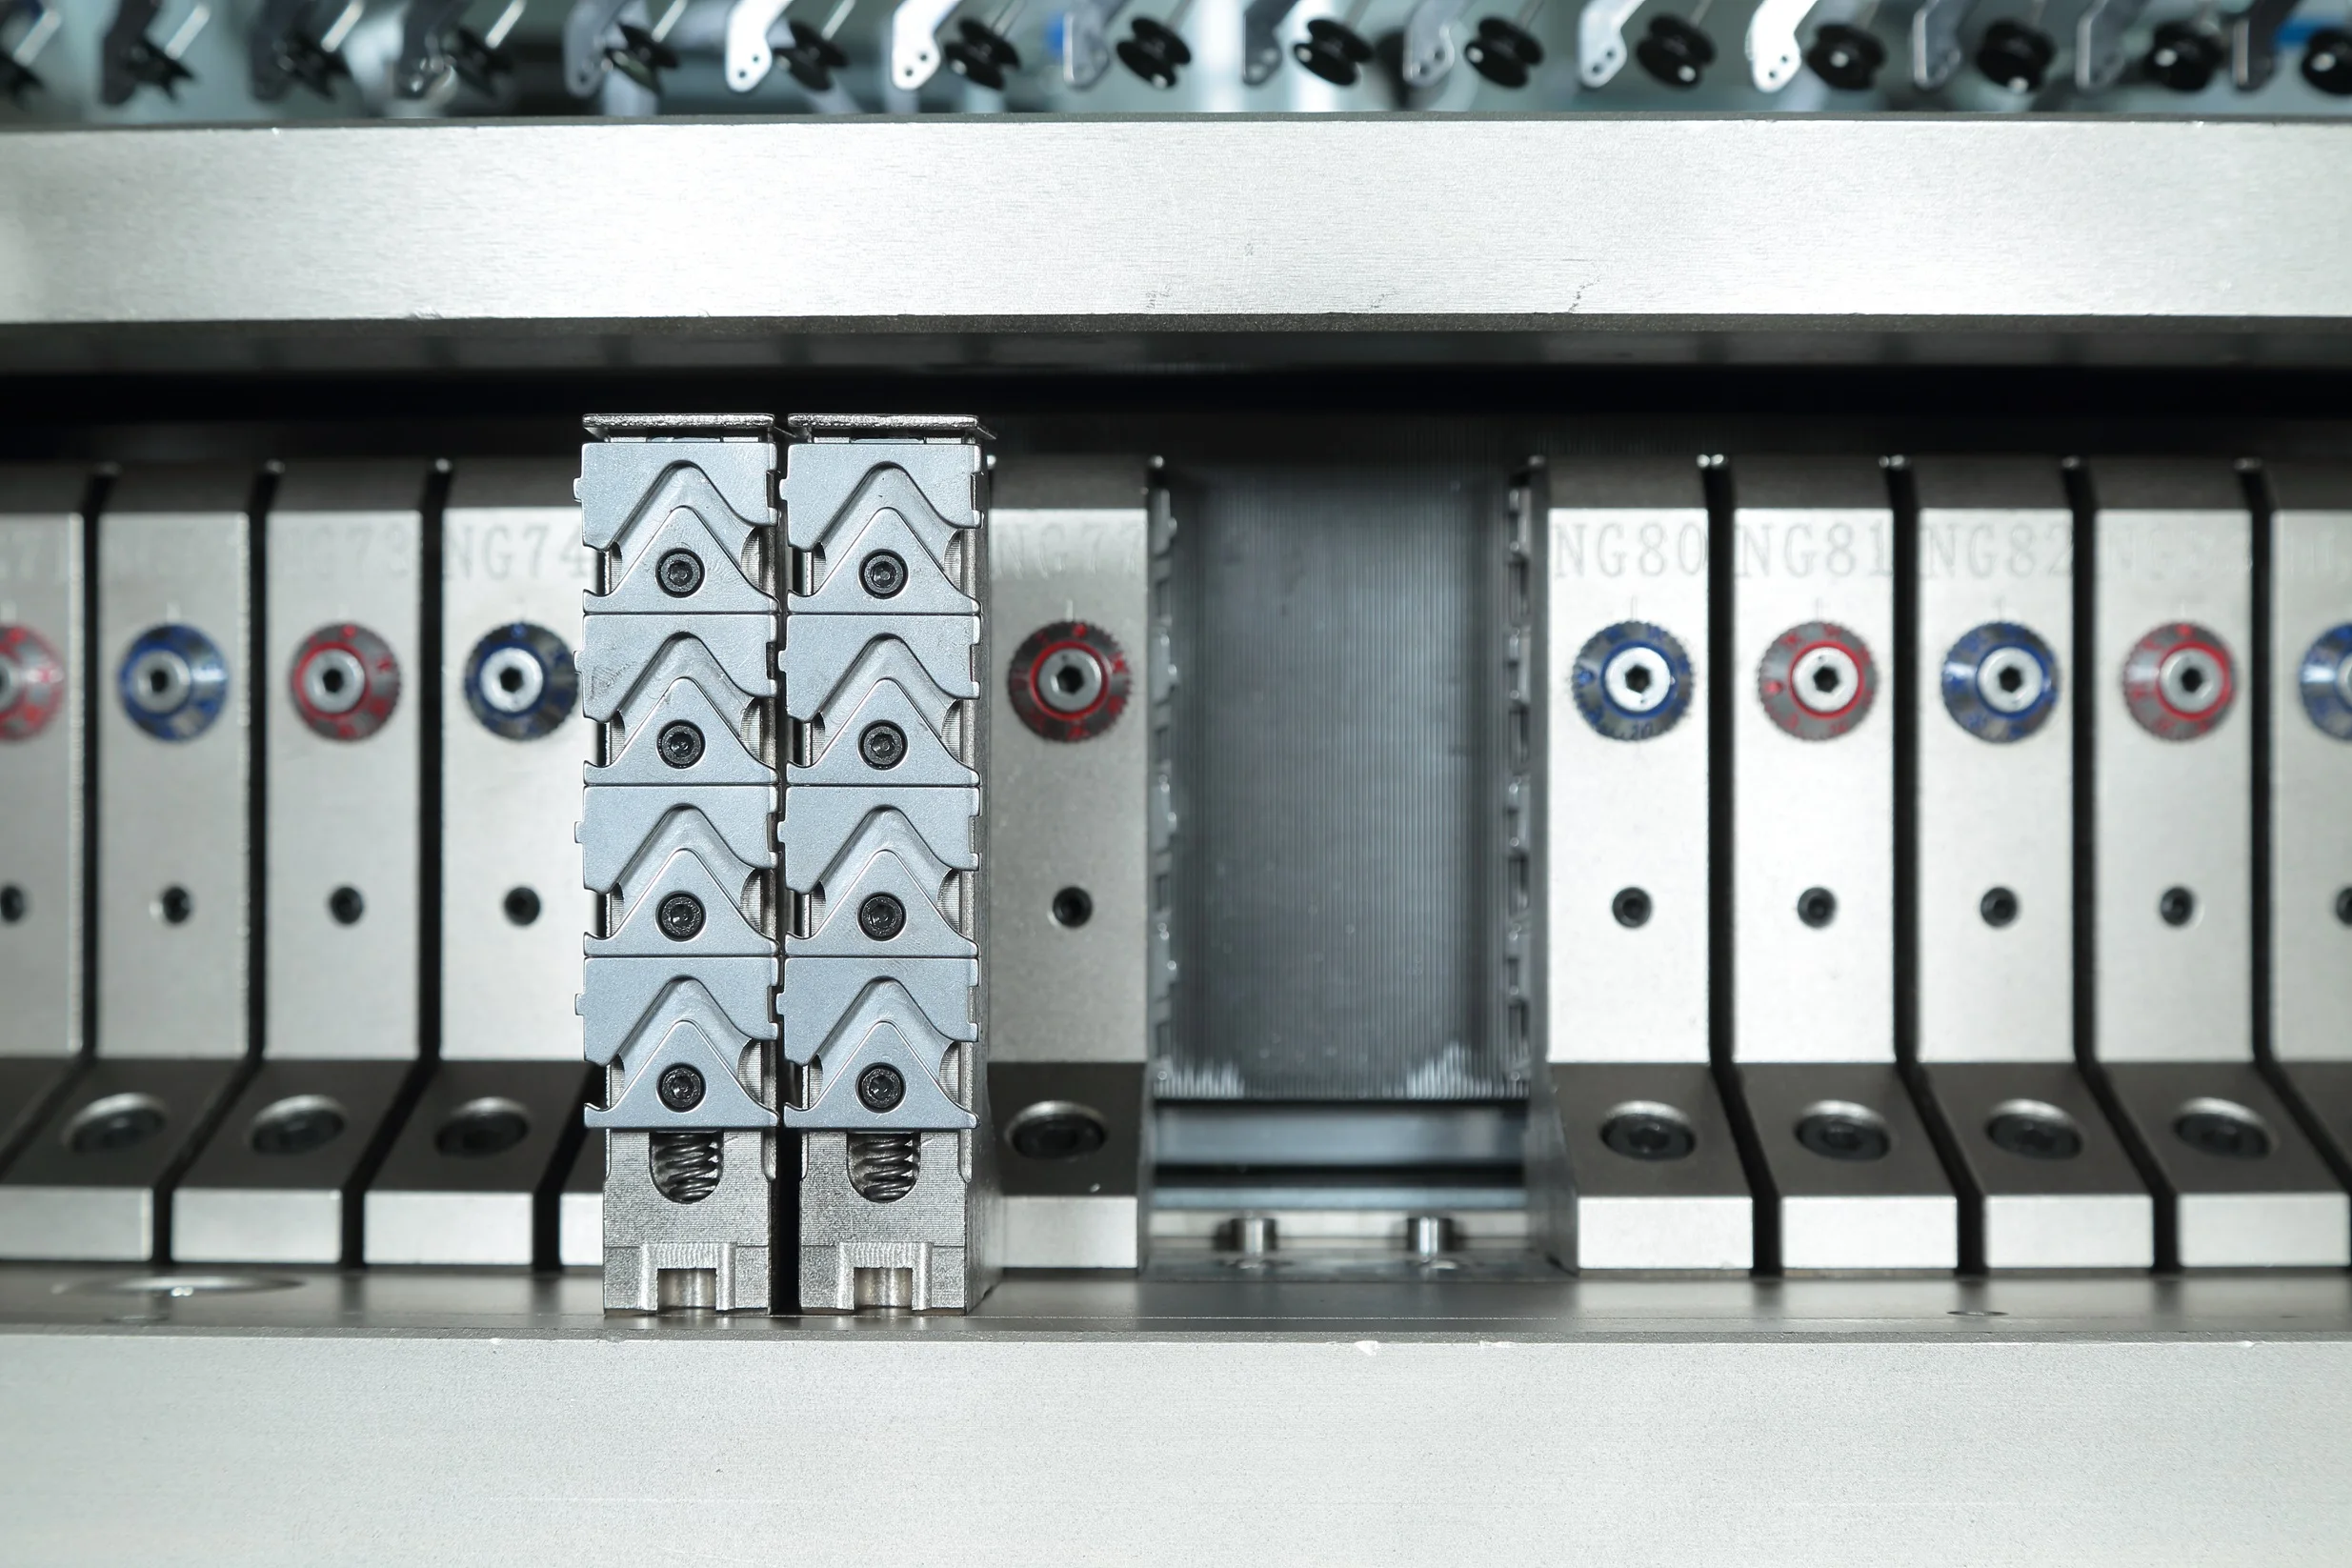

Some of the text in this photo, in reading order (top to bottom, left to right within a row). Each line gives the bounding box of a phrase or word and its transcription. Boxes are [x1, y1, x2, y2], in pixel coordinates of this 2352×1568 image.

[1555, 523, 1708, 577] NG80
[1735, 520, 1893, 577] NG81
[1920, 523, 2074, 578] NG82
